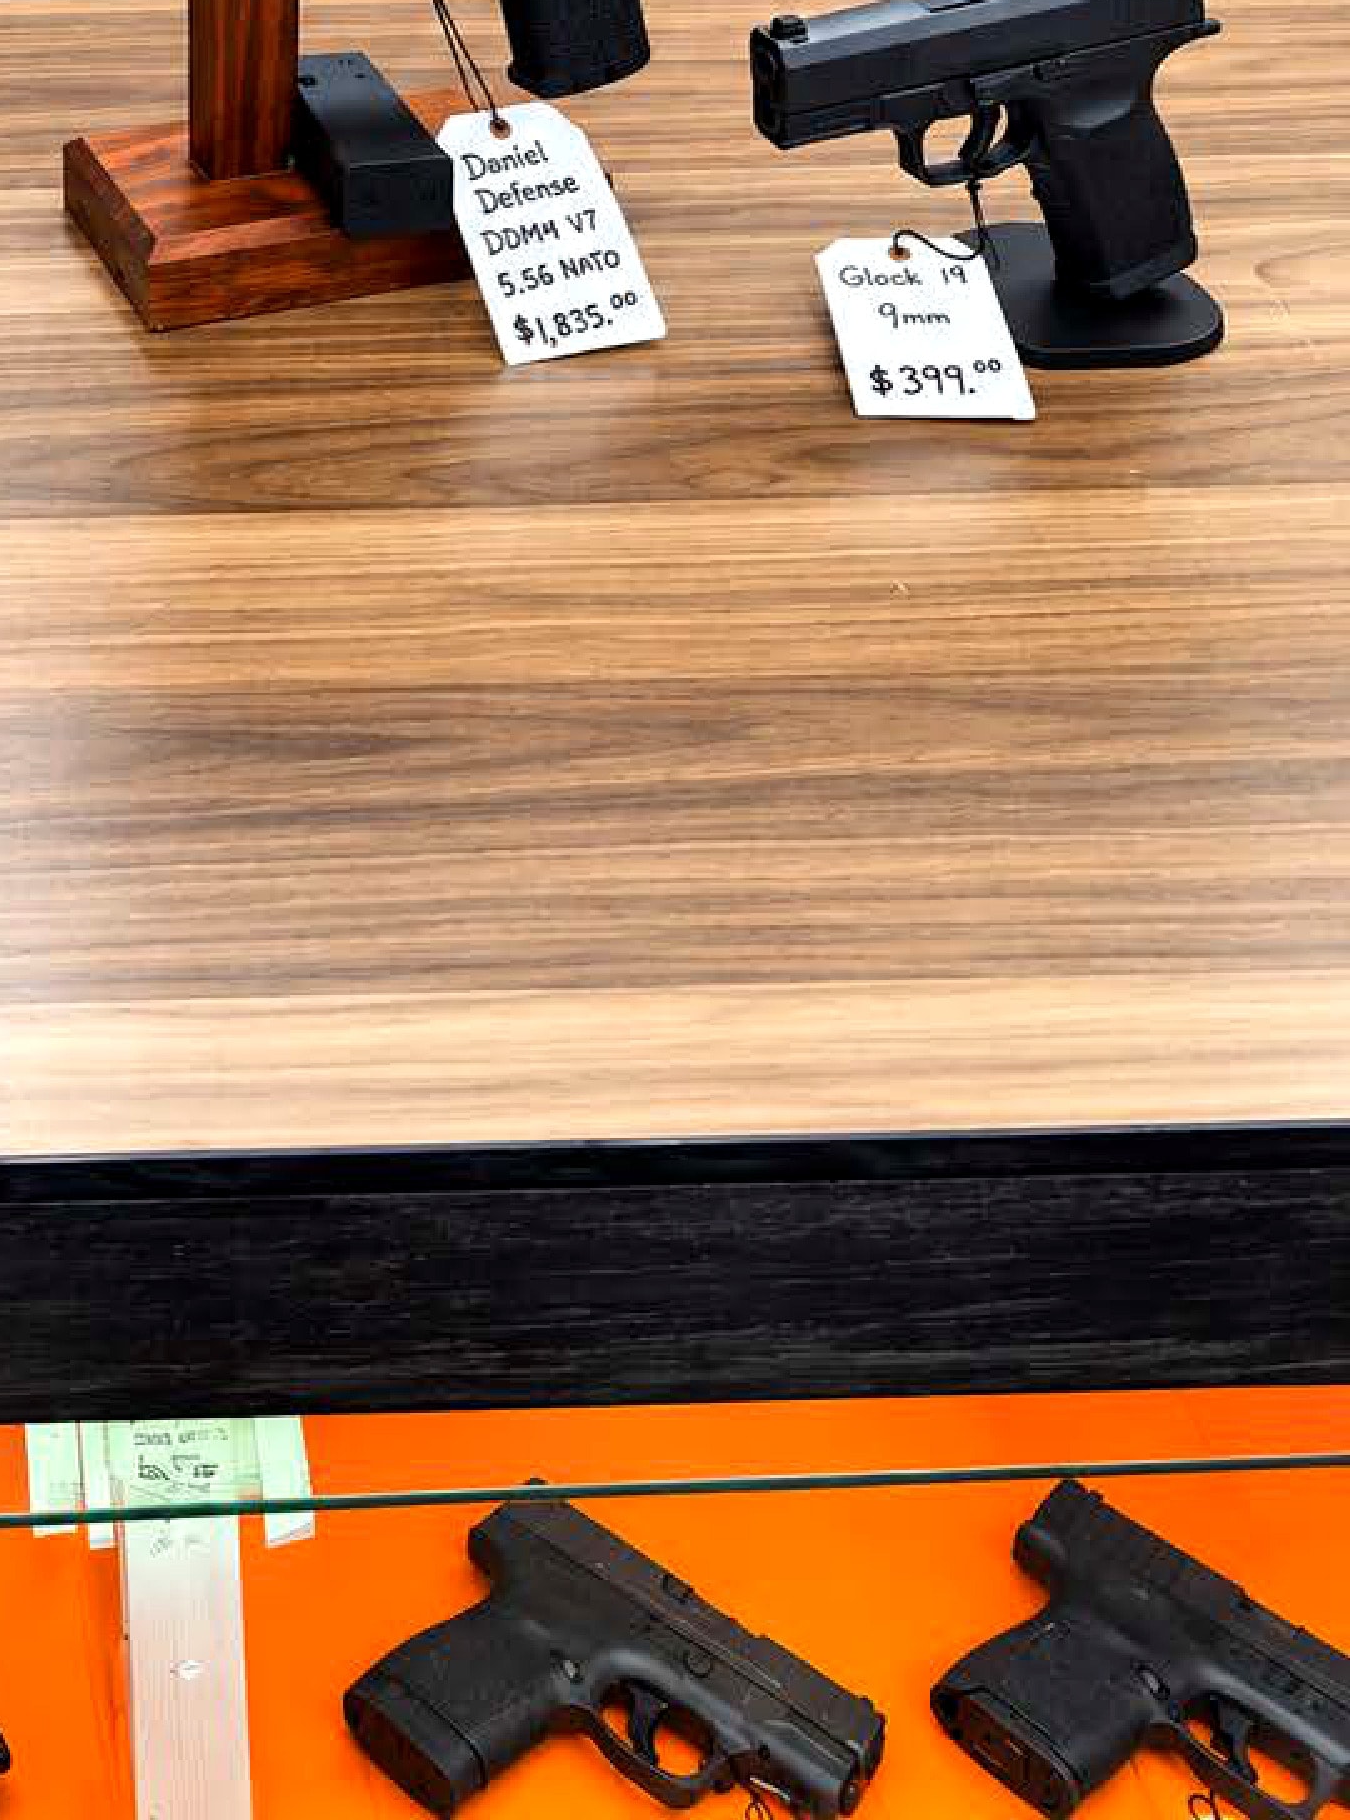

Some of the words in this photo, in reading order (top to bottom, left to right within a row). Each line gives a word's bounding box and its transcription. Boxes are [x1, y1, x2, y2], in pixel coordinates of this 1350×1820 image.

[460, 140, 548, 180] Daniel
[473, 175, 580, 214] Defense
[480, 220, 560, 255] DDM4
[564, 208, 596, 233] V7
[498, 264, 554, 298] 5.56
[559, 250, 620, 279] NATO
[838, 265, 923, 287] Glock
[940, 264, 969, 285] 19
[877, 302, 951, 328] 9mm
